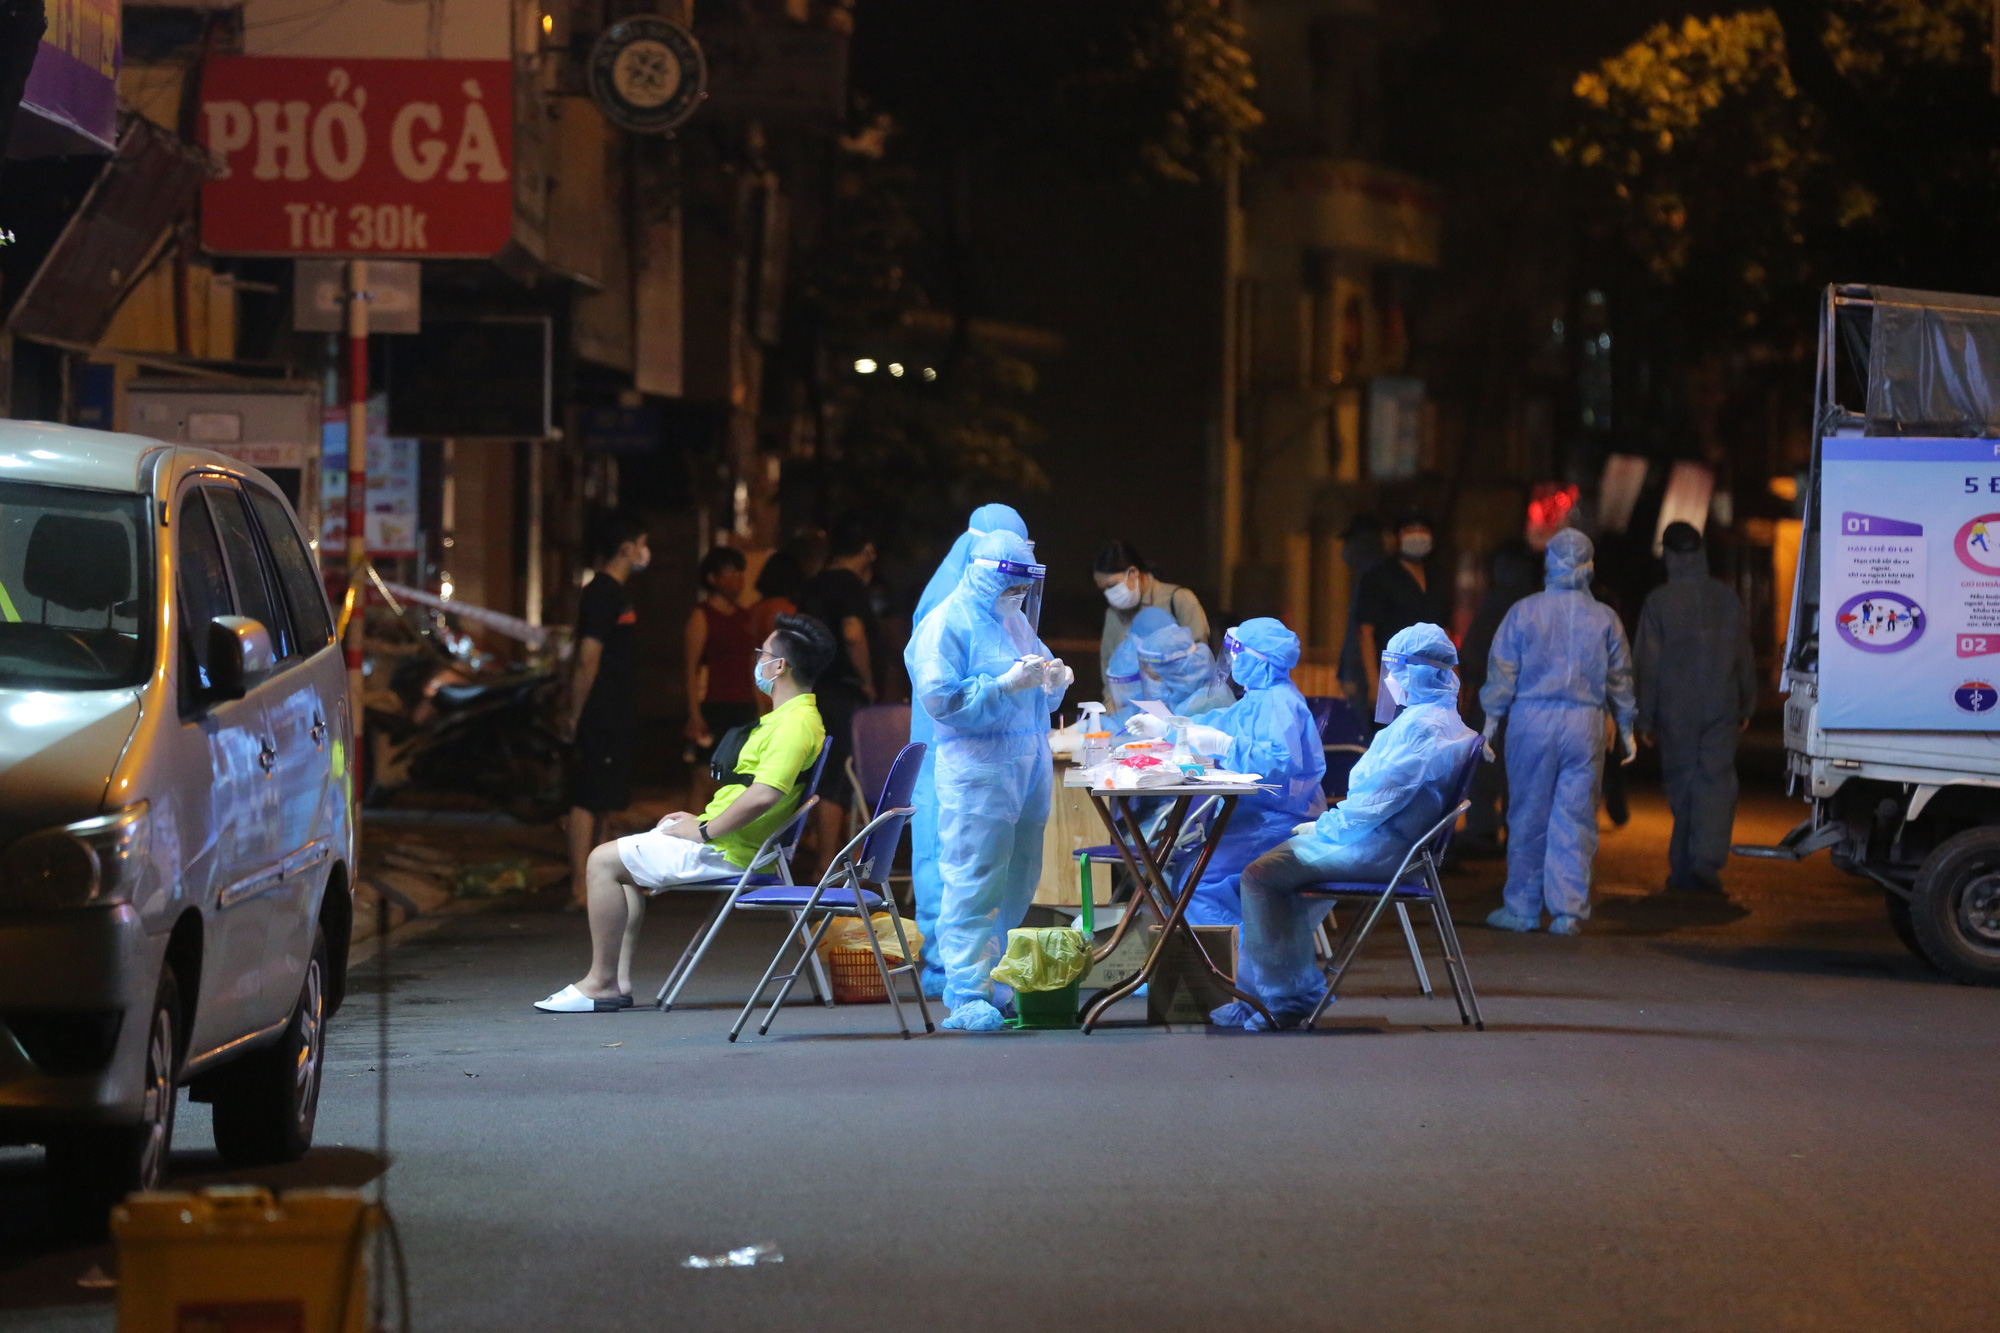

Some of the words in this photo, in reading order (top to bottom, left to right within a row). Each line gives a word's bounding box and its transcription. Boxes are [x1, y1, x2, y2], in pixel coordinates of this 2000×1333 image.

[203, 66, 369, 182] PHỞ
[390, 78, 508, 183] GÀ
[285, 201, 338, 249] Từ
[347, 204, 428, 250] 30k
[1964, 476, 1979, 493] 5
[1847, 517, 1870, 533] 01
[1961, 637, 1987, 652] 02
